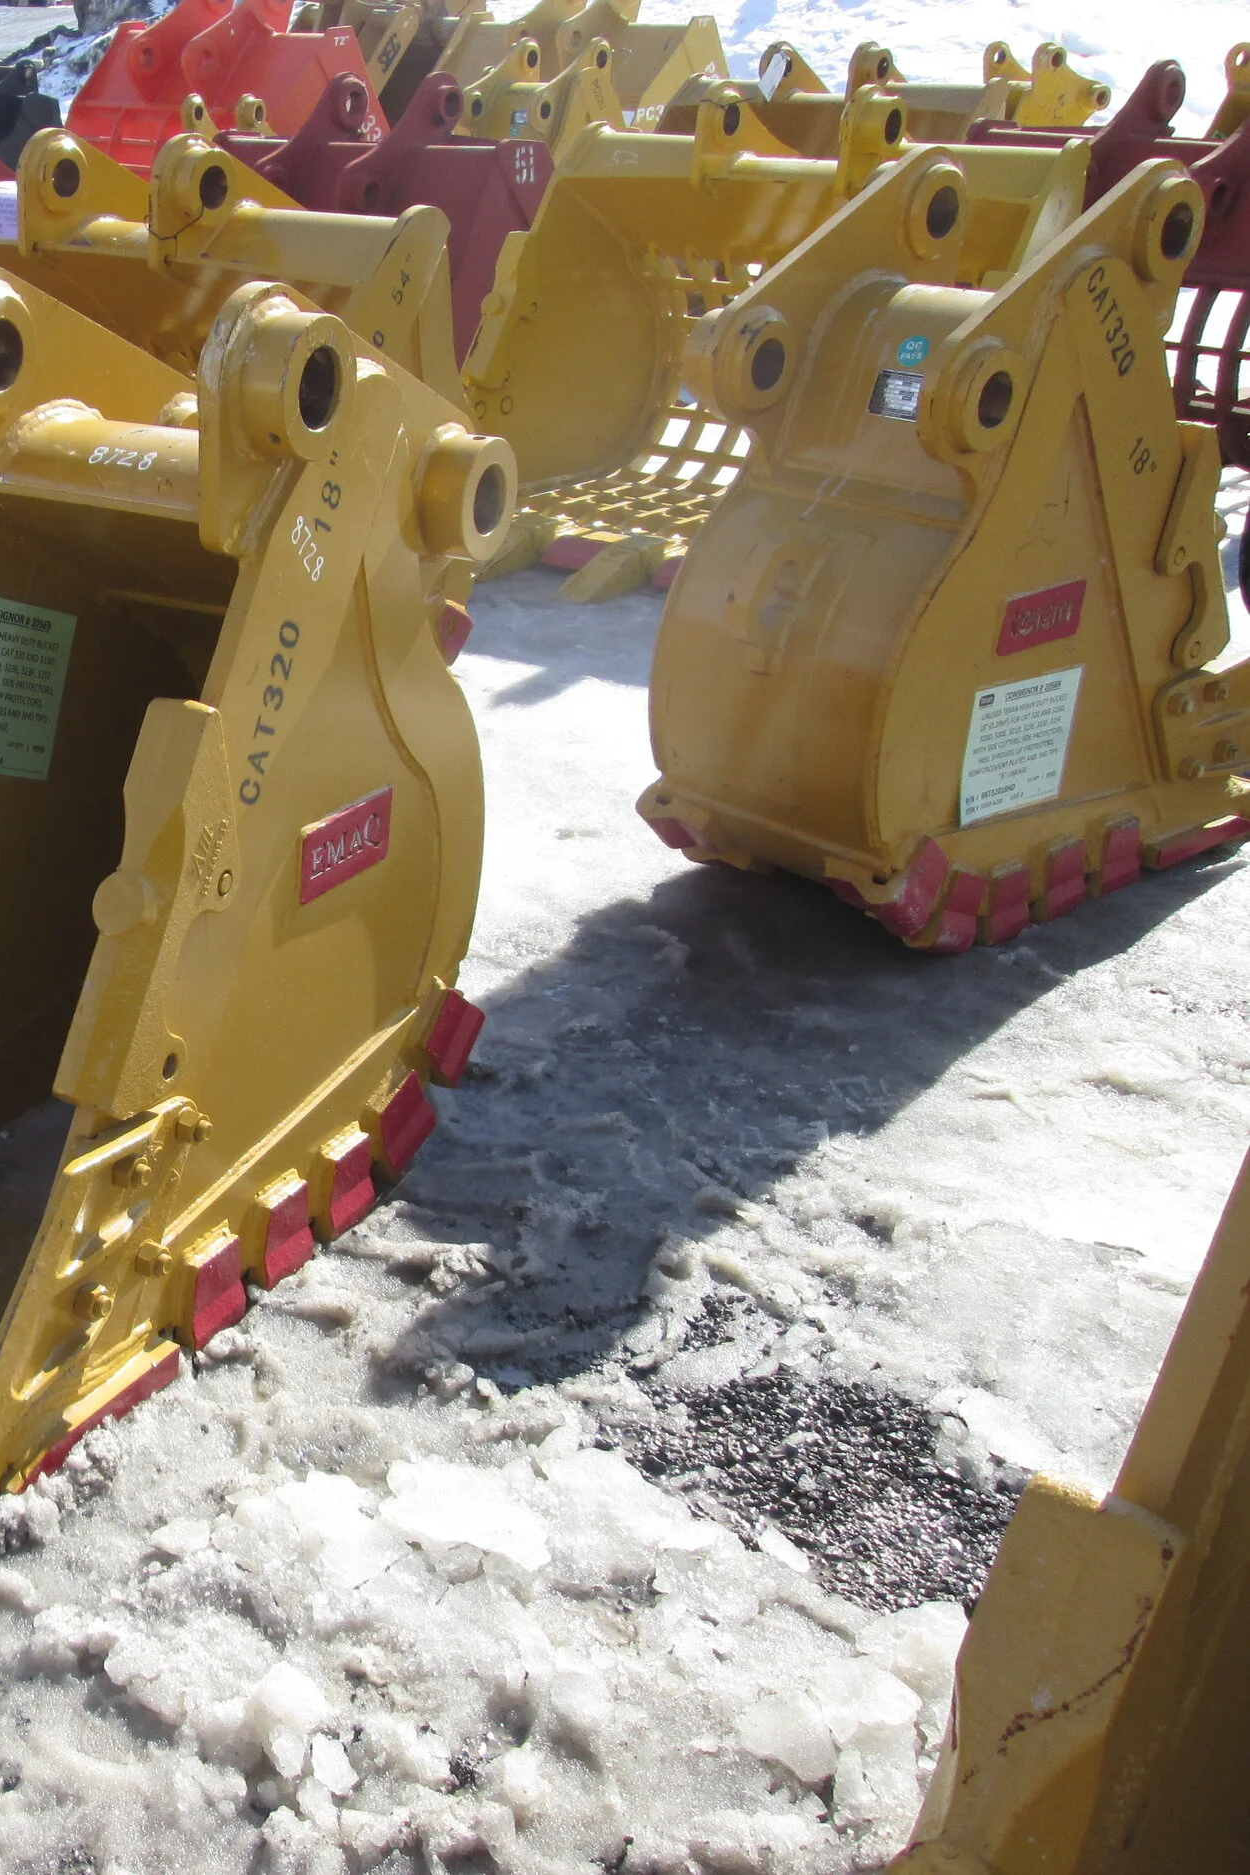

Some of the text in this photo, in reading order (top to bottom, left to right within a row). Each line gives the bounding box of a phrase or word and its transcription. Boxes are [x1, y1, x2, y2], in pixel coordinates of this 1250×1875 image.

[334, 36, 350, 46] 72"
[516, 146, 535, 184] 51
[906, 341, 923, 350] QC
[1086, 265, 1157, 475] CAT320 18"
[88, 446, 158, 471] 8728
[291, 515, 325, 582] 8728
[239, 450, 343, 806] CAT320 18"
[0, 632, 20, 643] HEAVY
[20, 636, 36, 647] DUTY
[36, 640, 59, 652] BUCKET
[1, 647, 14, 657] CAT
[24, 652, 39, 663] AND
[1, 677, 15, 688] SIDE
[7, 708, 20, 718] AND
